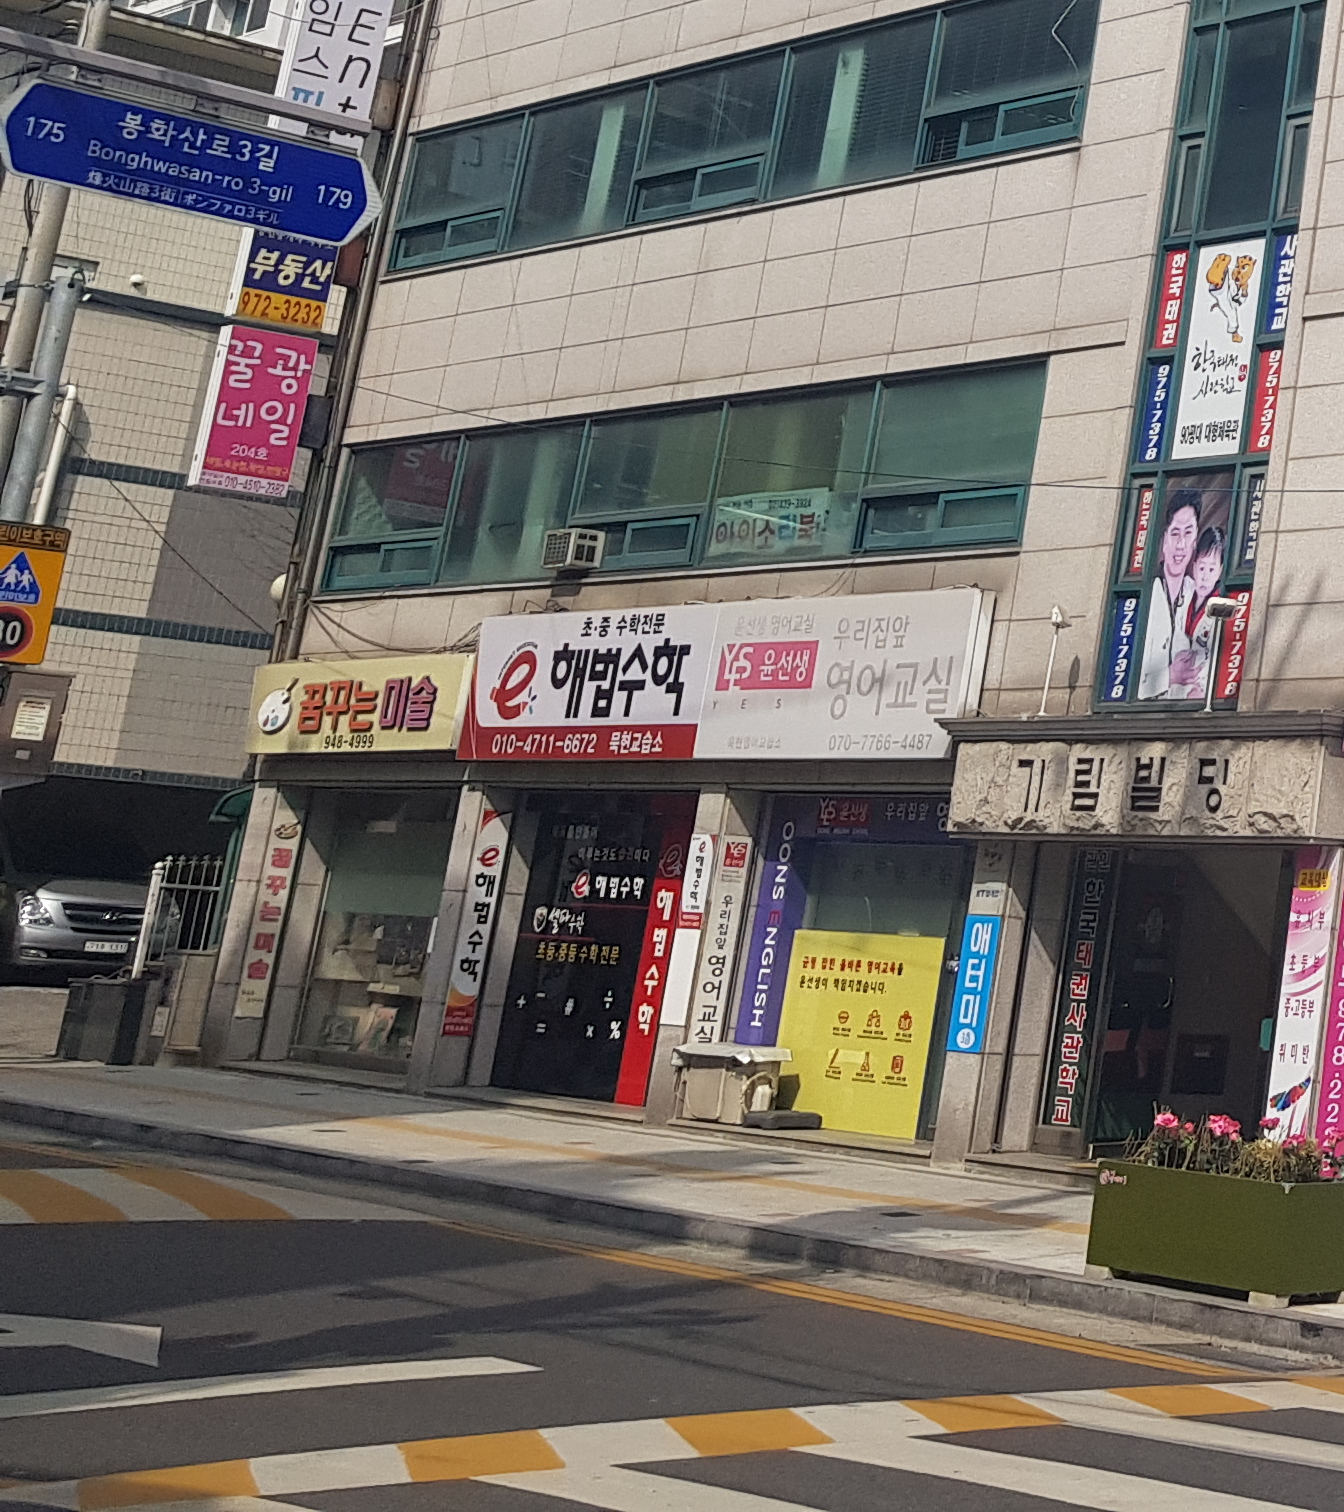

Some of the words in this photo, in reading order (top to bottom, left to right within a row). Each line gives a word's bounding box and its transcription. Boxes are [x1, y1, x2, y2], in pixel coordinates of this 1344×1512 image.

[24, 116, 67, 143] 175
[118, 110, 280, 173] 봉화산로3길
[86, 139, 244, 191] Bonghwasan-ro
[248, 177, 294, 203] 3-gil
[316, 184, 354, 211] 179
[249, 247, 333, 291] 부동산
[240, 290, 323, 326] 972-3232
[1161, 252, 1187, 345] 한국태권
[226, 338, 312, 396] 꿀광
[215, 400, 296, 447] 네일
[1144, 364, 1171, 461] 975-7378
[1257, 349, 1282, 449] 975-7378
[229, 443, 269, 462] 204호
[615, 613, 667, 636] 수학전문
[770, 613, 816, 634] 영어교실
[833, 615, 911, 651] 우리집앞
[1110, 598, 1137, 699] 975-7378
[550, 638, 692, 719] 해법수학
[758, 648, 811, 682] 윤선생
[826, 656, 955, 721] 영어교실
[297, 679, 379, 734] 꿈꾸는
[379, 675, 439, 731] 미술
[323, 733, 375, 750] 948-4999
[491, 732, 598, 755] 010-4711-6672
[828, 733, 933, 751] 070-7766-4487
[1017, 757, 1230, 815] 기림빌딩
[594, 875, 645, 900] 해법수학
[459, 872, 497, 983] 해법수학
[637, 889, 674, 1036] 해법수학
[750, 910, 782, 1028] ENGLISH
[958, 921, 993, 1029] 애터미
[694, 954, 727, 1044] 영어교실
